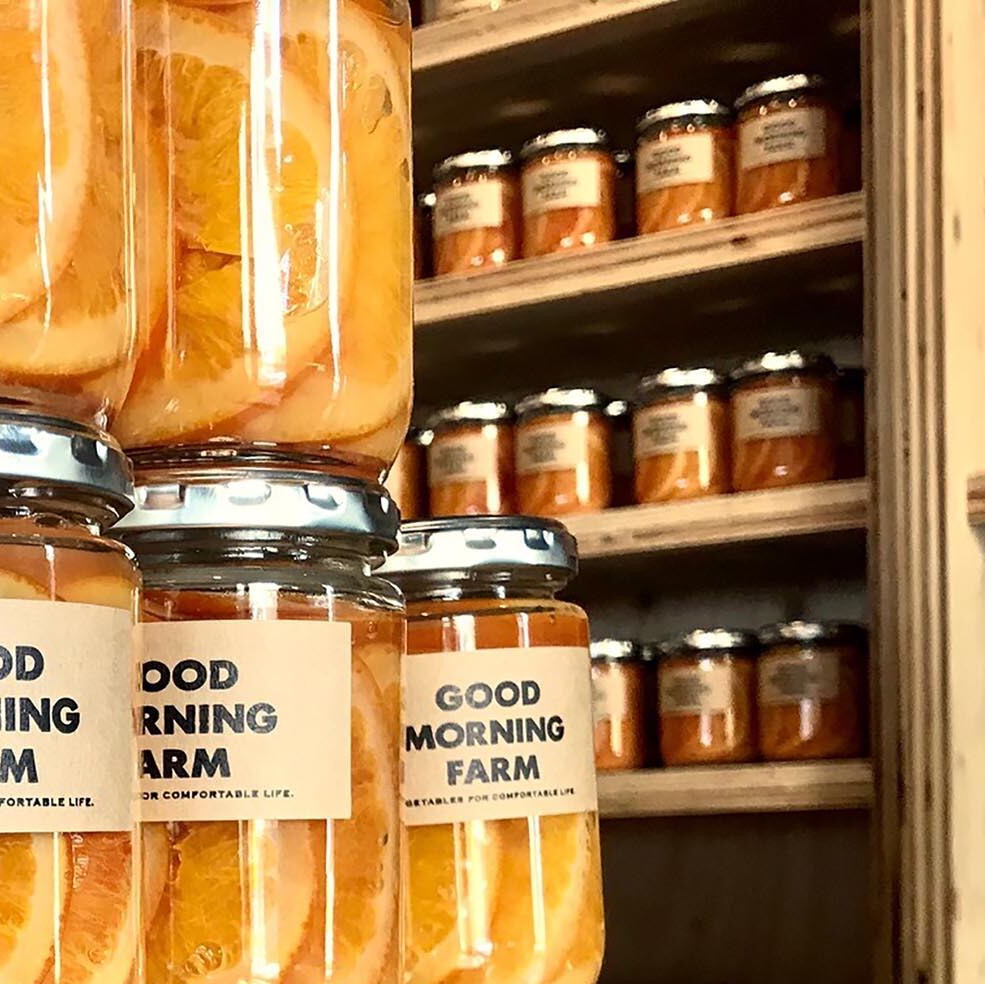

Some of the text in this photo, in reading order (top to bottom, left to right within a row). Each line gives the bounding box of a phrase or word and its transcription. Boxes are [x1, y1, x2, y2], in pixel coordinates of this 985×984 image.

[435, 680, 541, 712] GOOD
[140, 702, 278, 735] RNING
[405, 715, 565, 752] MORNING
[140, 747, 231, 779] ARM
[446, 754, 540, 786] FARM
[69, 796, 94, 807] LIFE.
[163, 790, 258, 800] COMFORTABLE
[264, 789, 294, 798] LIFE.
[468, 794, 489, 803] FOR
[492, 788, 558, 801] COMFORTABLE
